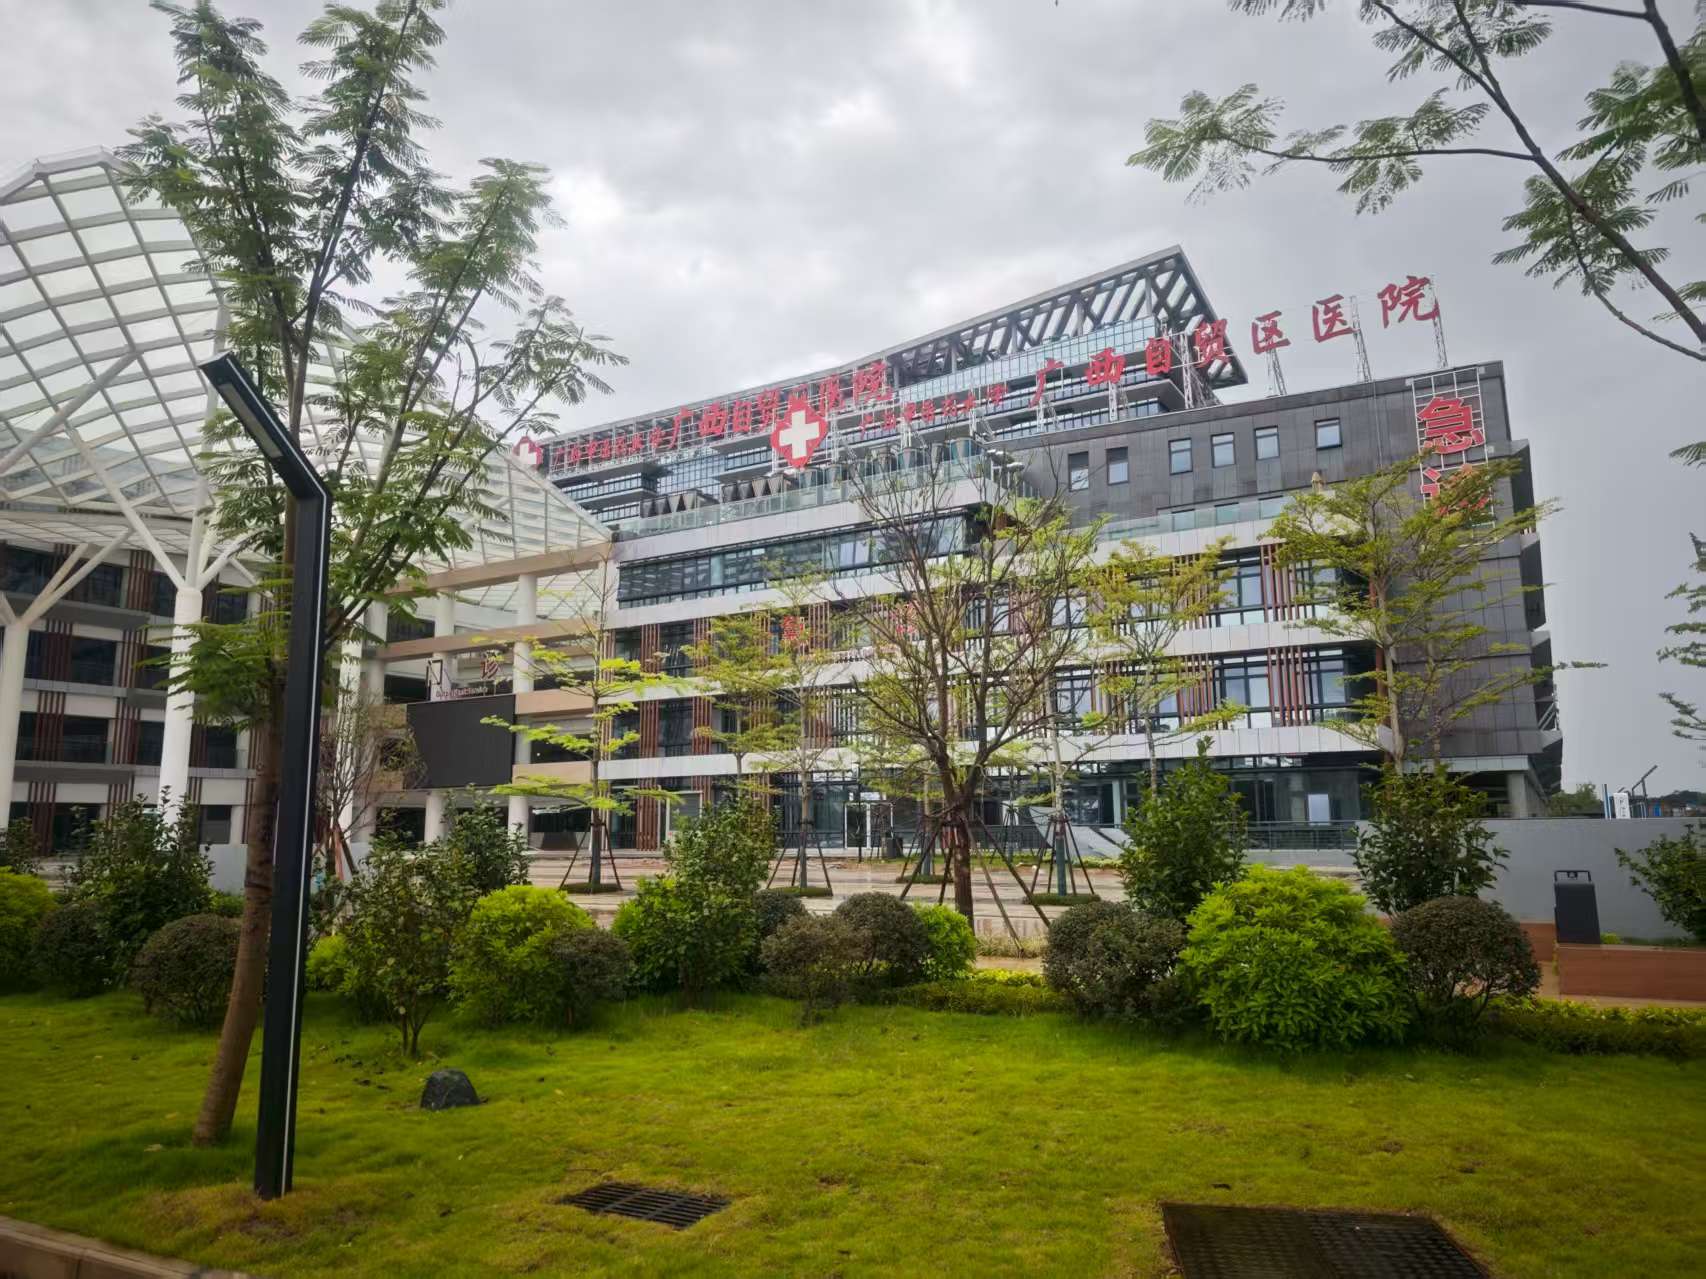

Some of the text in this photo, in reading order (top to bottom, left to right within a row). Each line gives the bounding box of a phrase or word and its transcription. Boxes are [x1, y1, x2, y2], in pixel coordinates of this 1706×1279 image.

[1030, 277, 1440, 404] 广西自贸区医院
[669, 361, 893, 449] 广西自贸医院
